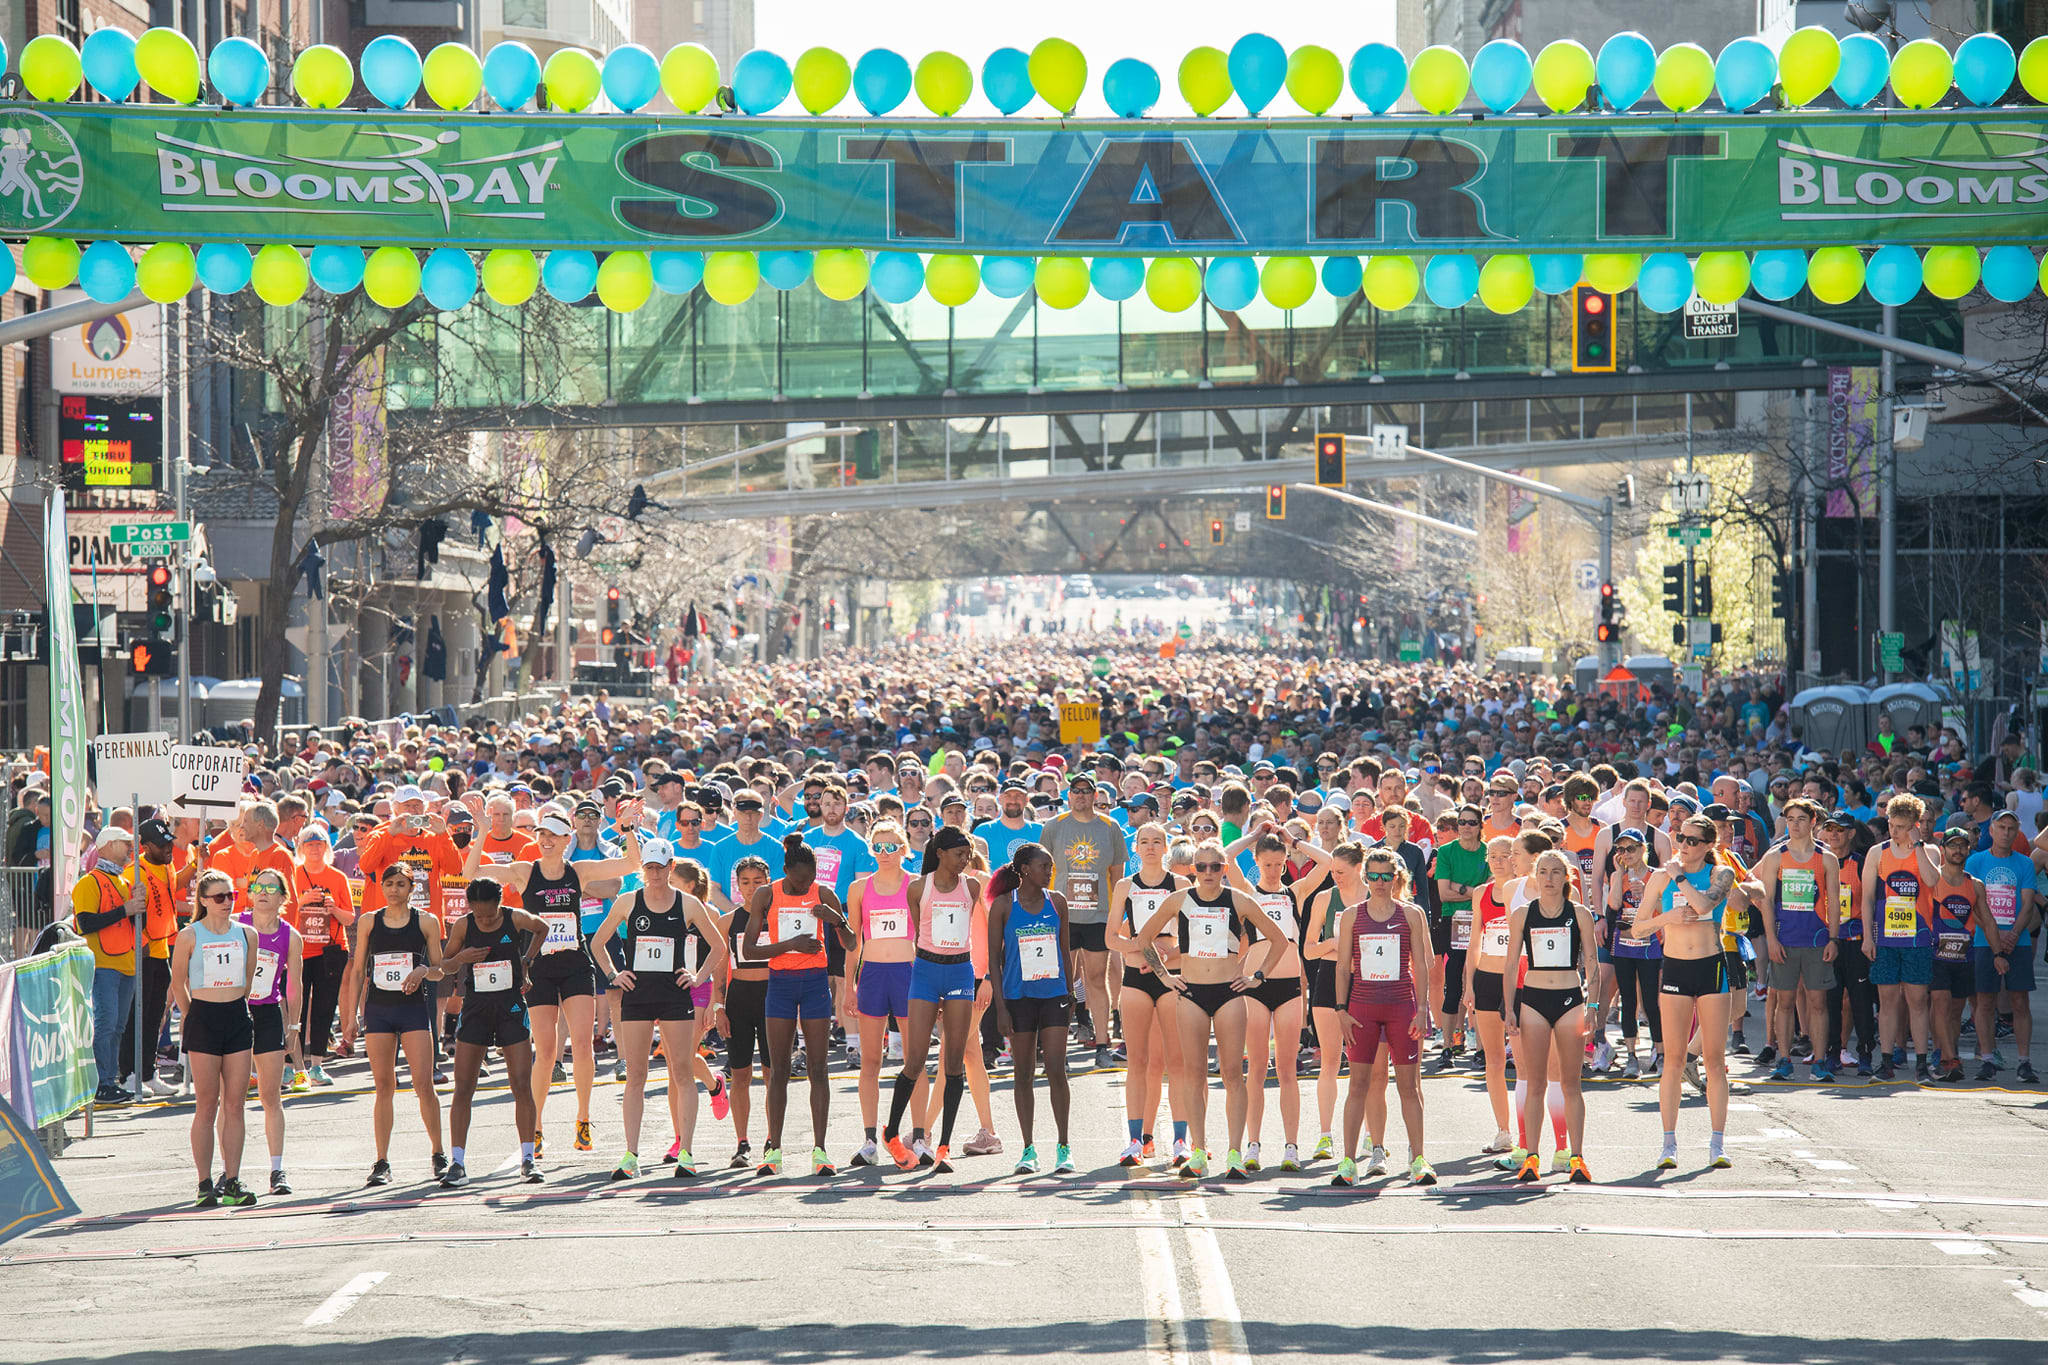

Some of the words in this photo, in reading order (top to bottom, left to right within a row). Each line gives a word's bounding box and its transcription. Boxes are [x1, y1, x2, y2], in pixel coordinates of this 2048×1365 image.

[157, 146, 558, 205] BLOOMSDAY
[611, 130, 1729, 246] START
[1693, 314, 1731, 326] EXCEPT
[1691, 324, 1733, 337] TRANSIT
[71, 362, 142, 379] Lumen
[72, 381, 97, 389] HIGH
[100, 381, 142, 389] SCHOOL
[126, 525, 173, 541] Post
[139, 544, 164, 555] 100N
[1061, 707, 1099, 721] YELLOW
[96, 739, 169, 760] PERENNIALS
[171, 752, 243, 774] CORPORATE
[191, 774, 220, 792] CUP
[1073, 883, 1092, 893] 546
[1784, 882, 1813, 893] 13877
[447, 898, 466, 908] 418
[1148, 900, 1156, 910] 8
[305, 916, 325, 927] 462
[948, 913, 954, 924] 1
[1888, 911, 1913, 921] 4909
[552, 923, 566, 933] 72
[794, 919, 801, 930] 3
[882, 920, 896, 931] 70
[1205, 924, 1212, 935] 5
[1547, 939, 1555, 951] 9
[647, 948, 661, 959] 10
[1036, 946, 1044, 957] 2
[1375, 945, 1383, 957] 4
[217, 953, 230, 965] 11
[386, 971, 401, 982] 68
[489, 973, 497, 984] 6
[1370, 972, 1390, 980] Itron
